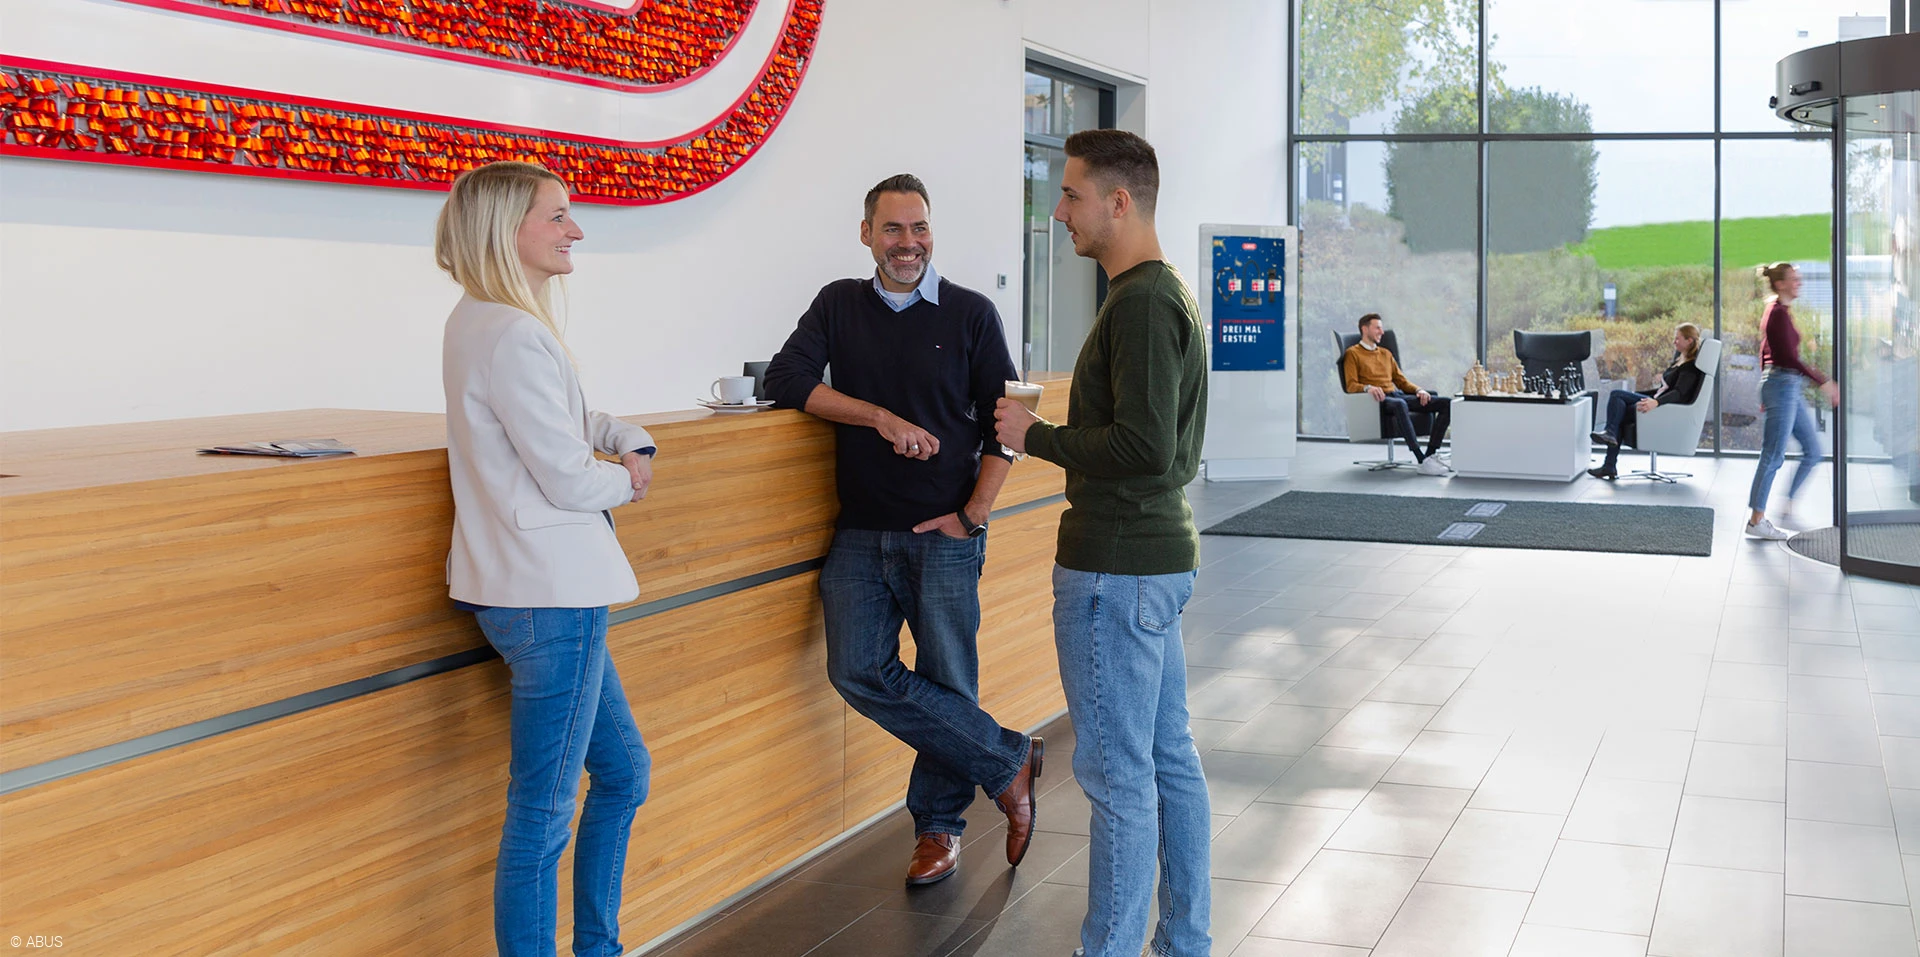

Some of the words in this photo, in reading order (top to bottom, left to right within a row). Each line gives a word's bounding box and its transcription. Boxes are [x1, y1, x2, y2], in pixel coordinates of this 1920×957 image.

[1222, 325, 1242, 334] DREI
[1245, 325, 1262, 334] MAL
[1222, 334, 1257, 343] ERSTER!
